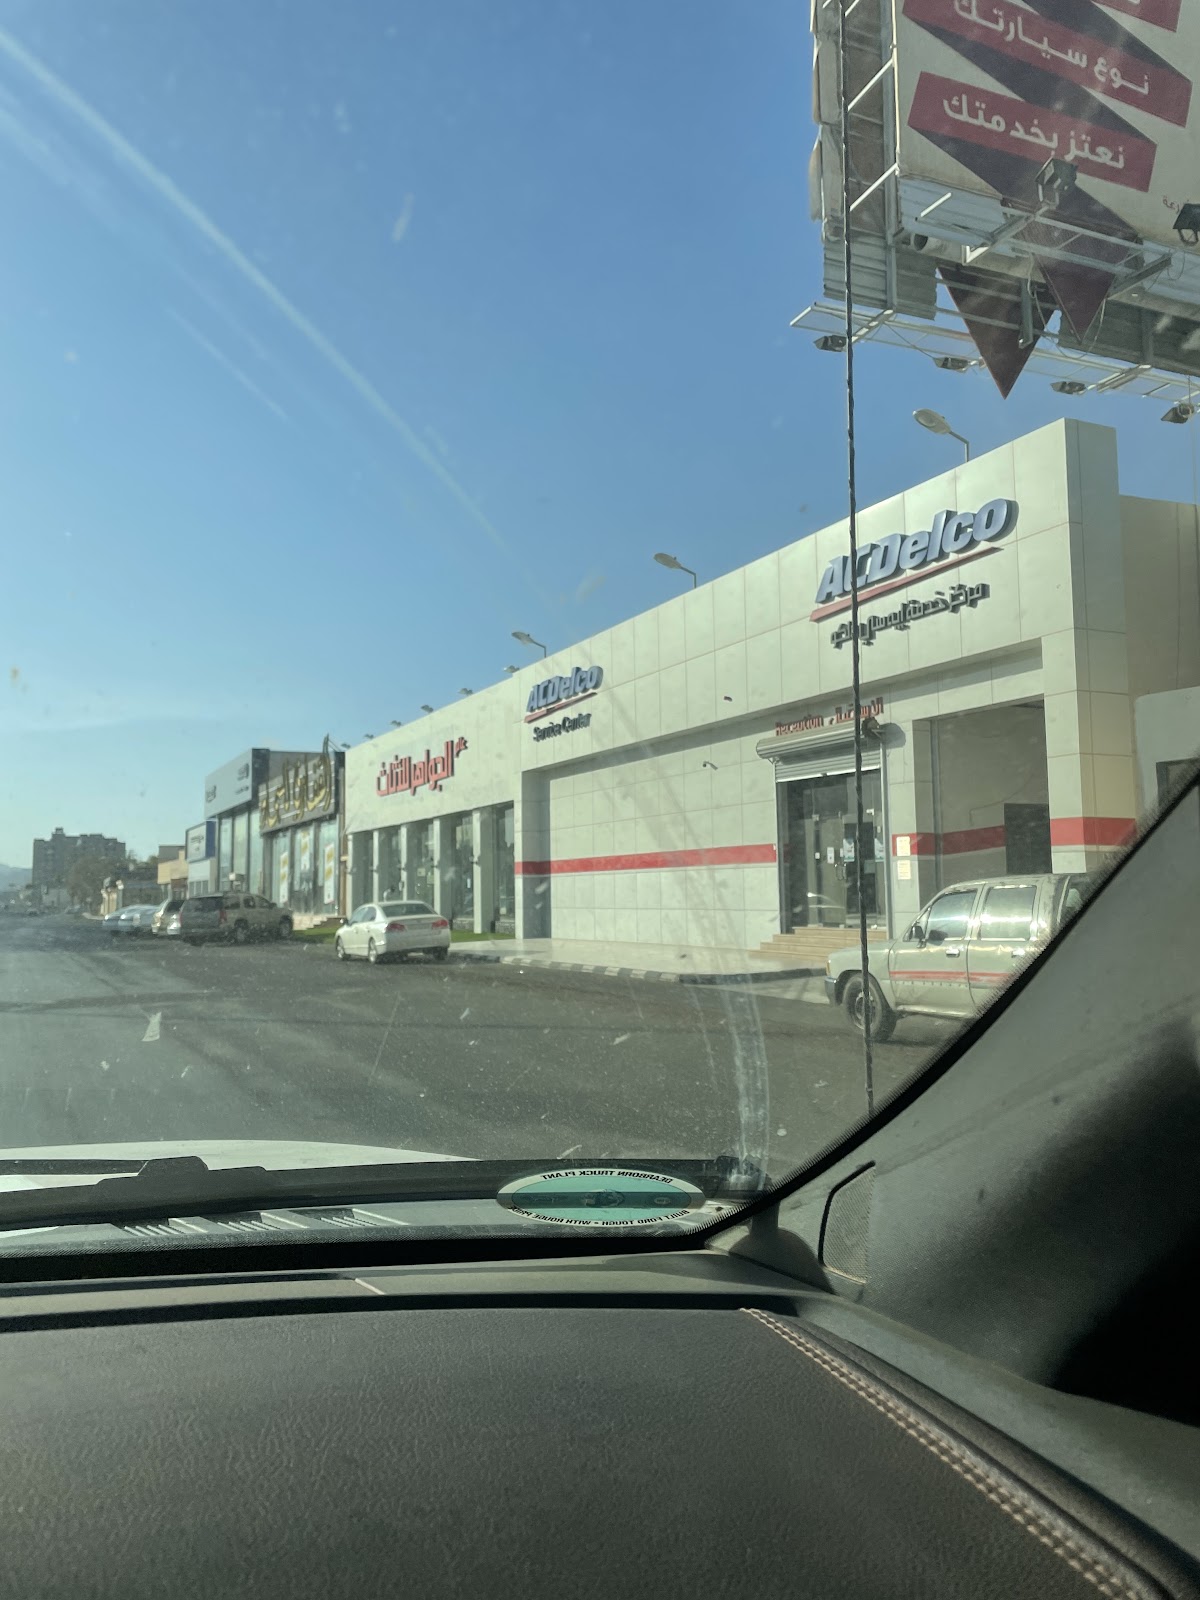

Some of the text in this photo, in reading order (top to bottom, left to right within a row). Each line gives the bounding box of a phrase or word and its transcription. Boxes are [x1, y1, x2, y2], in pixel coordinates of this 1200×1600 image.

[954, 0, 1150, 95] نوع سيارتك
[943, 94, 1125, 169] نعتز بخدمتك
[815, 497, 1020, 603] ACDelco
[906, 591, 949, 621] خدمة
[949, 583, 991, 614] مركز
[526, 665, 604, 713] ACDelco
[533, 713, 592, 742] Service Center
[410, 740, 455, 797] الجواهر
